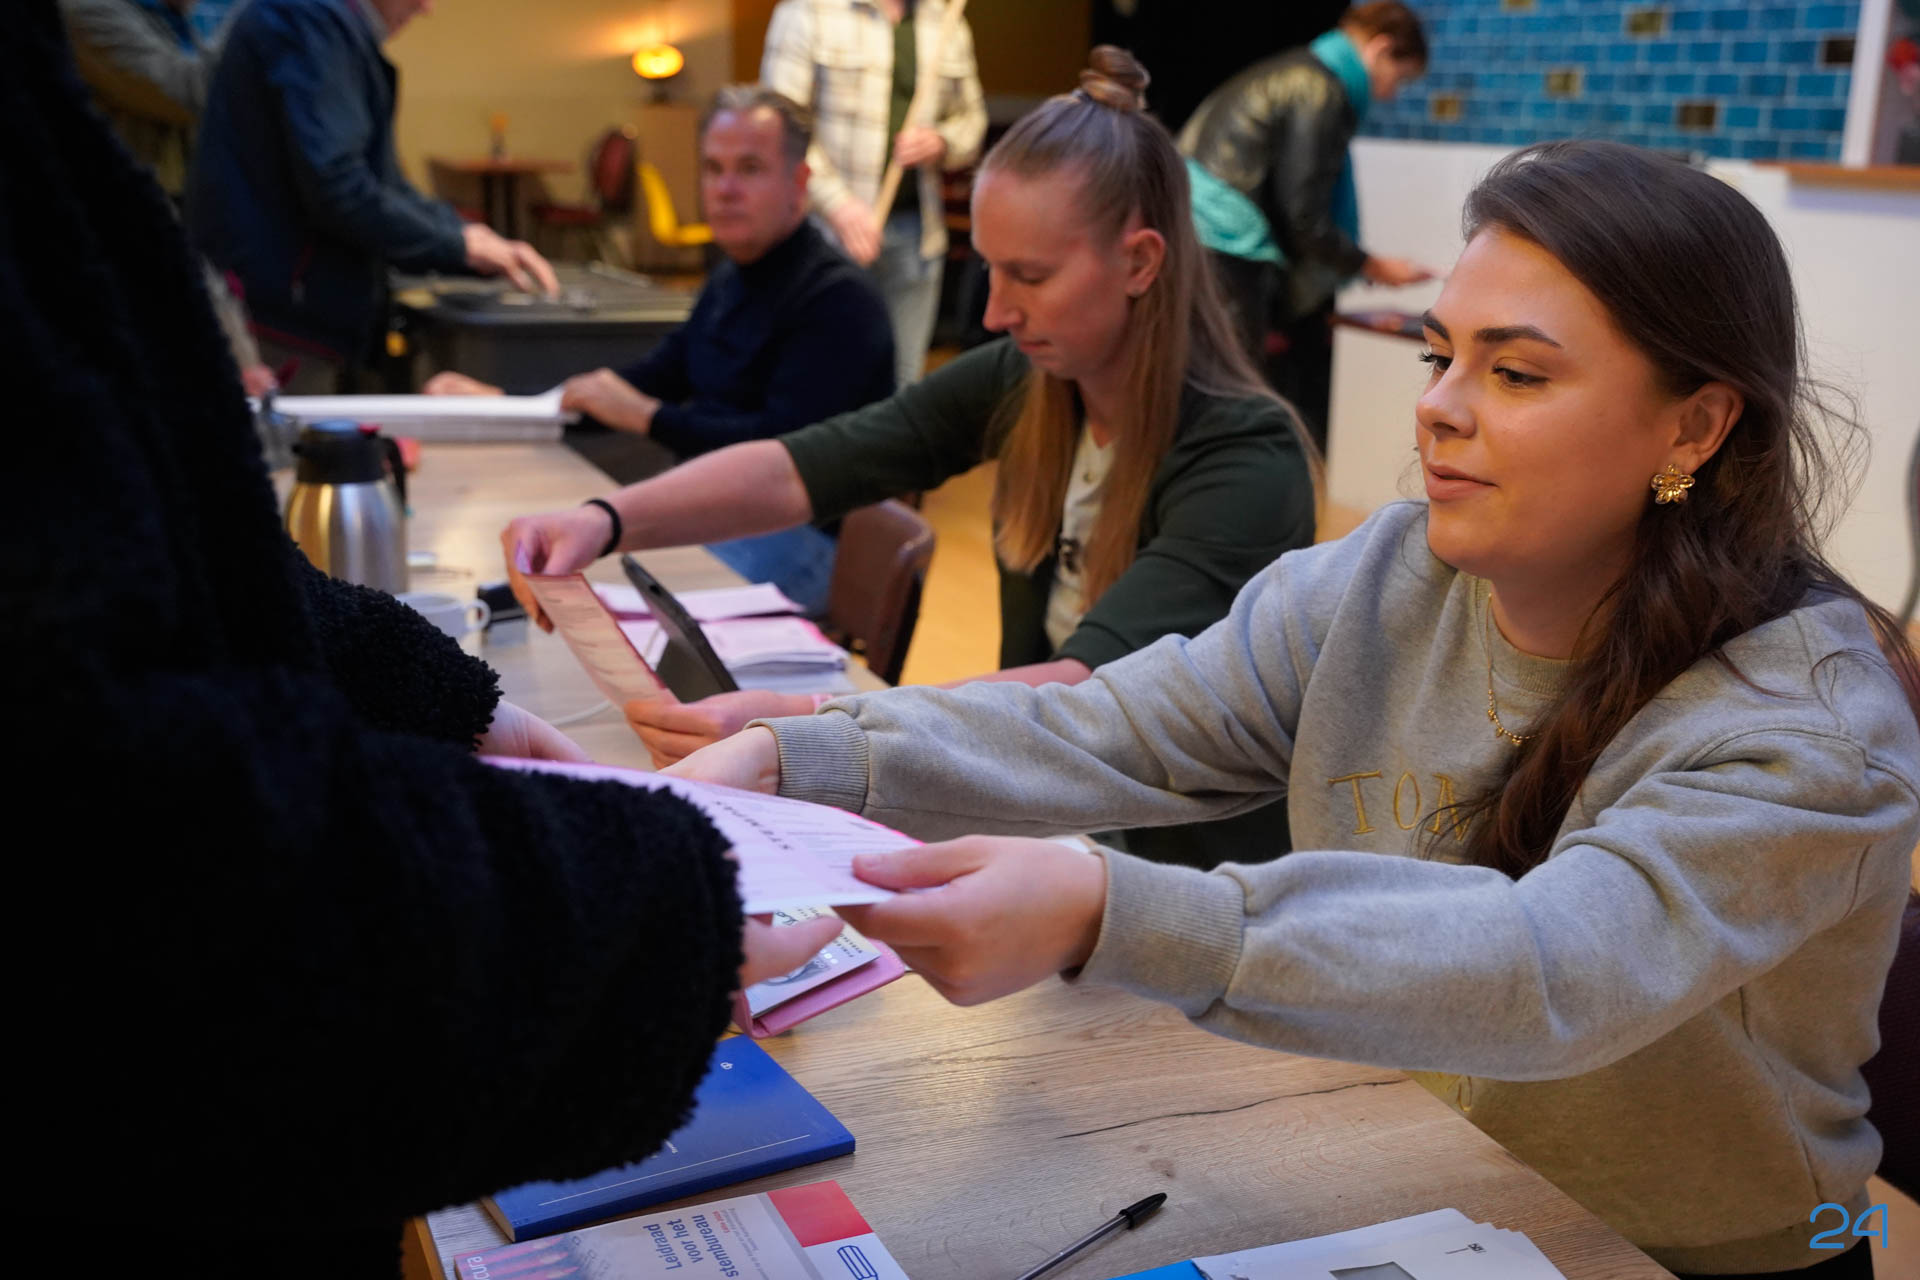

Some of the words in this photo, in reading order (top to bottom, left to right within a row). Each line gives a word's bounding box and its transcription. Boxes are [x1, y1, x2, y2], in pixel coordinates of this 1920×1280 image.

[666, 1218, 690, 1239] het
[691, 1214, 740, 1278] stembureau
[642, 1223, 683, 1270] Leidraad
[680, 1240, 704, 1264] voor
